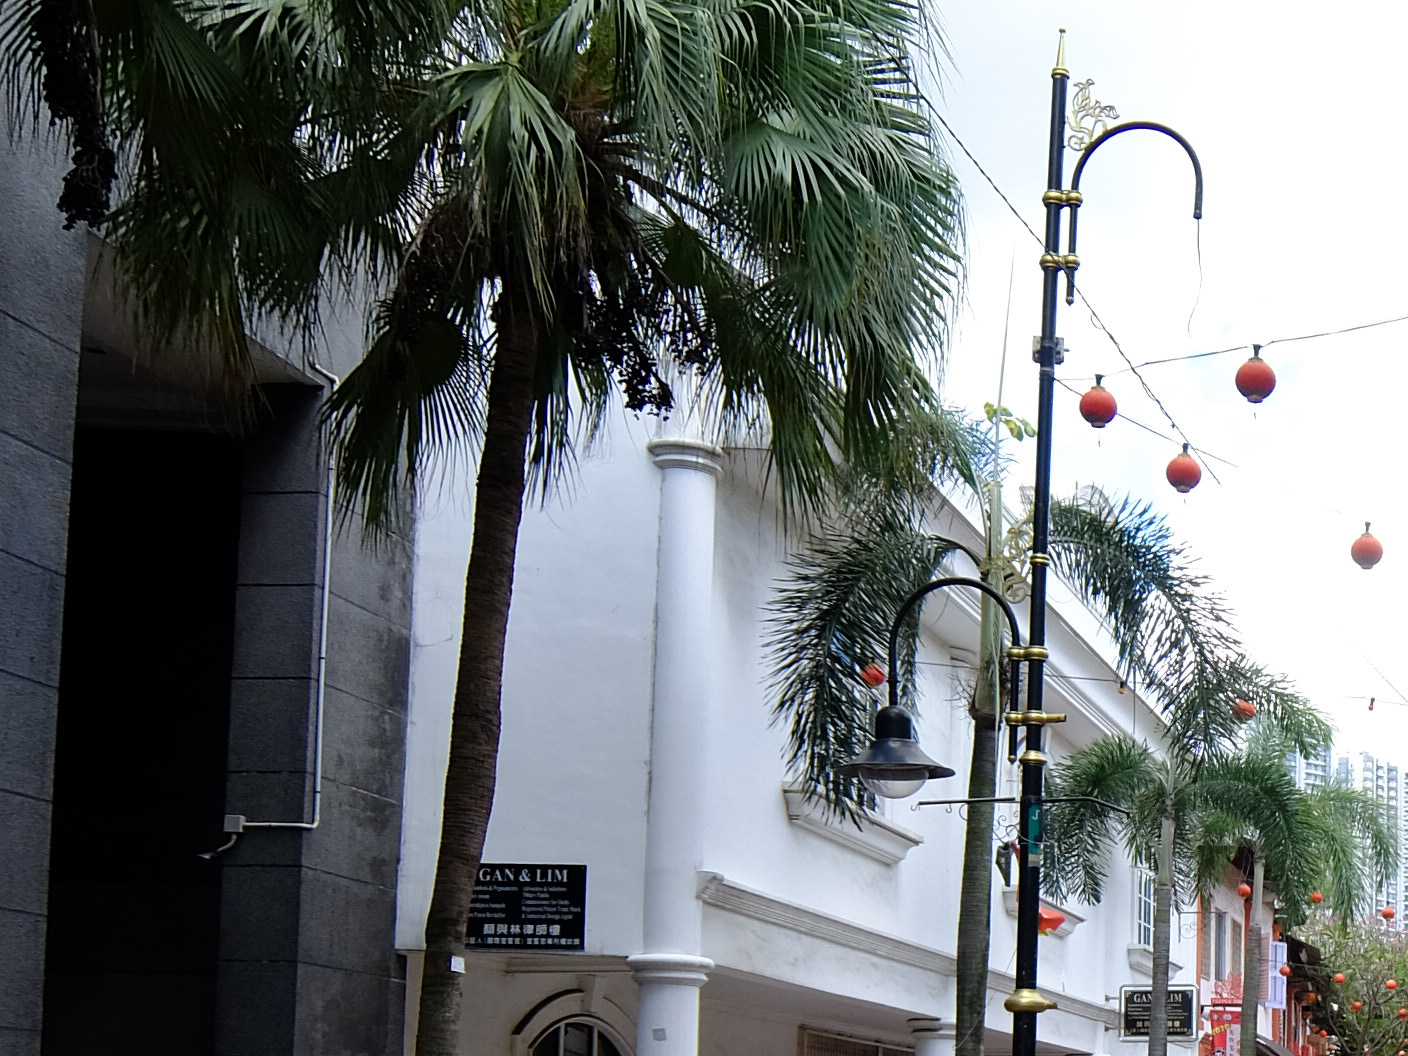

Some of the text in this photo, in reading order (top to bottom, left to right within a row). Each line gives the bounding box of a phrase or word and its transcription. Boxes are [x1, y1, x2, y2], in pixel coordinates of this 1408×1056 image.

[479, 868, 568, 883] GAN & LIM
